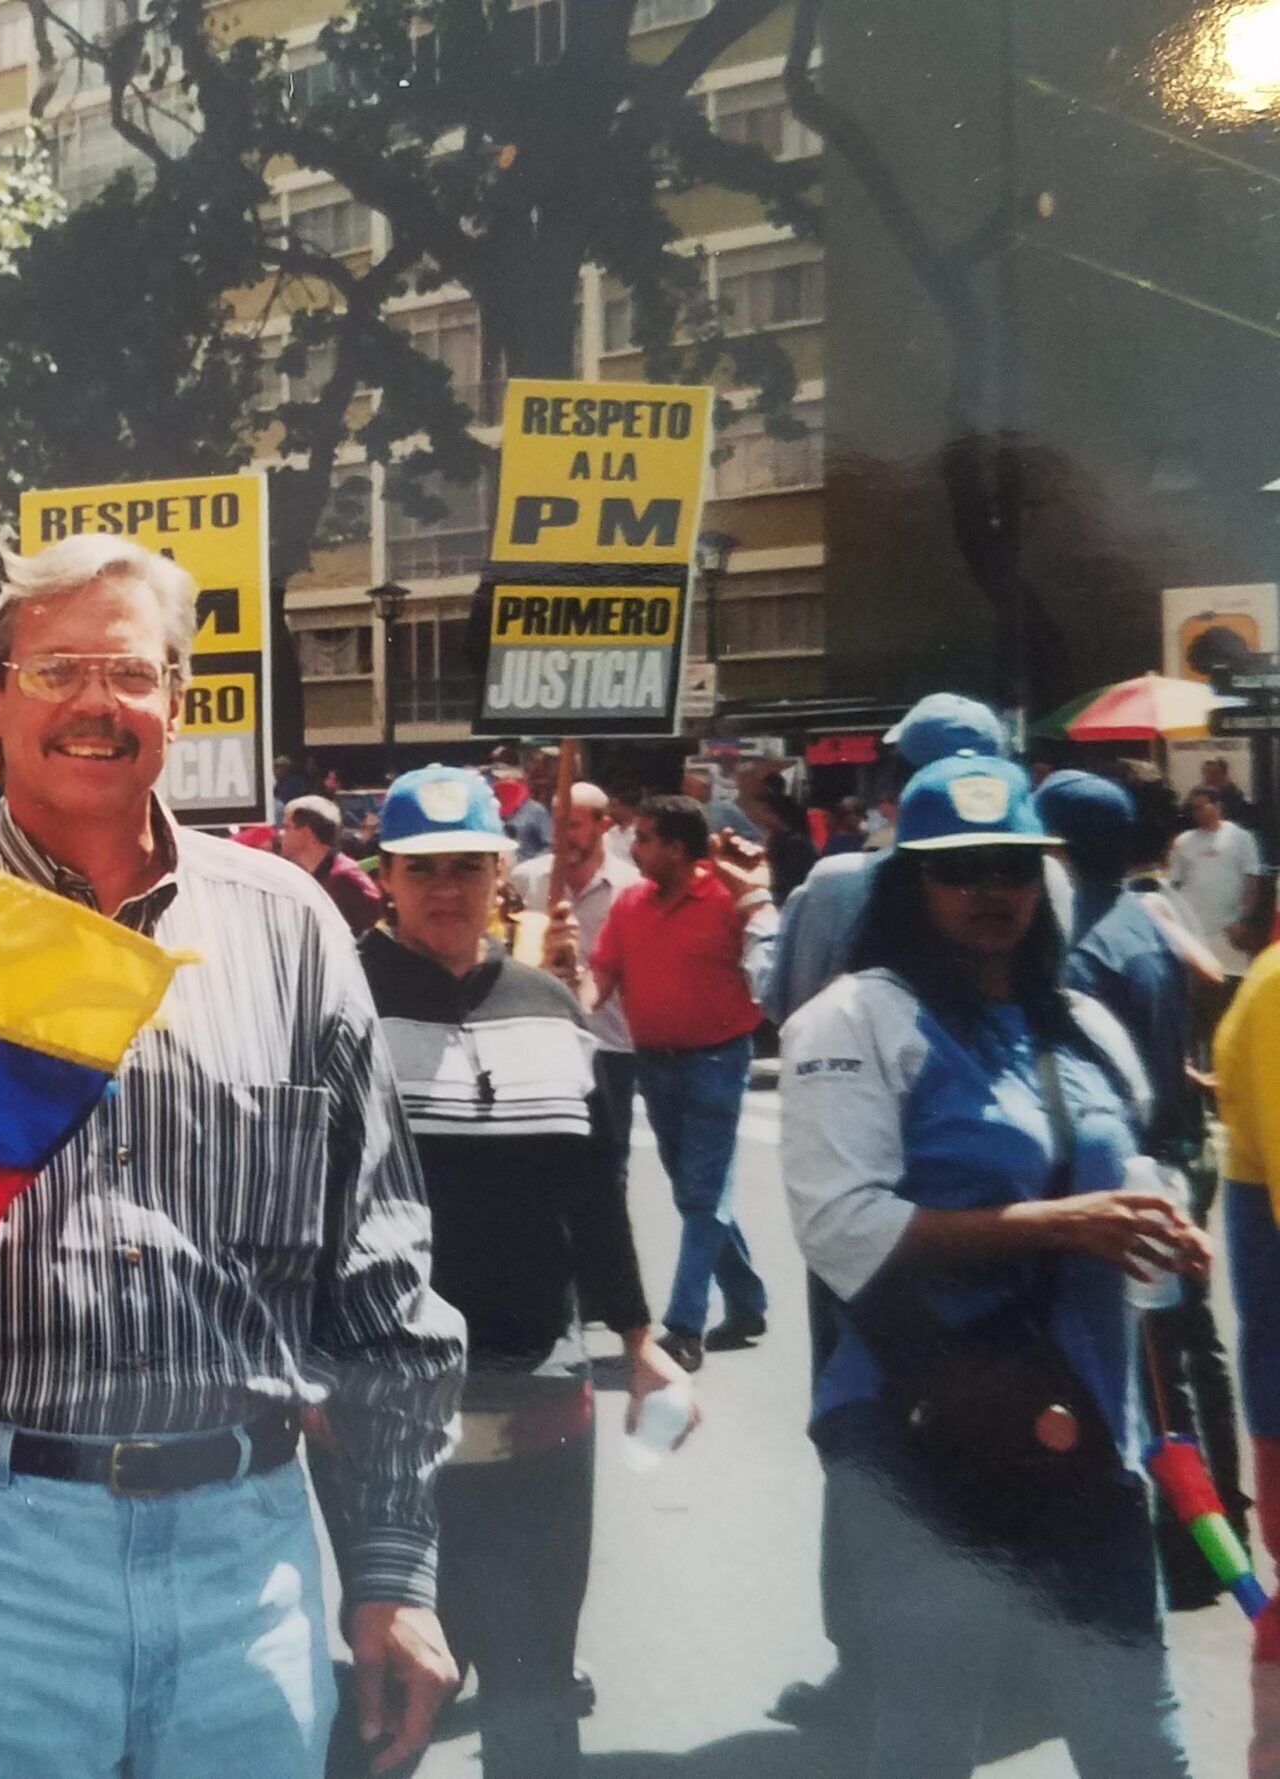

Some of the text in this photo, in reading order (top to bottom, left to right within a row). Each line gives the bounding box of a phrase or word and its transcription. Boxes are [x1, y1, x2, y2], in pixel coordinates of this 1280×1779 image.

[522, 396, 693, 440] RESPETO
[568, 451, 638, 481] A LA
[40, 492, 239, 542] RESPETO
[495, 596, 671, 636] PRIMERO
[487, 650, 666, 710] JUSTICIA
